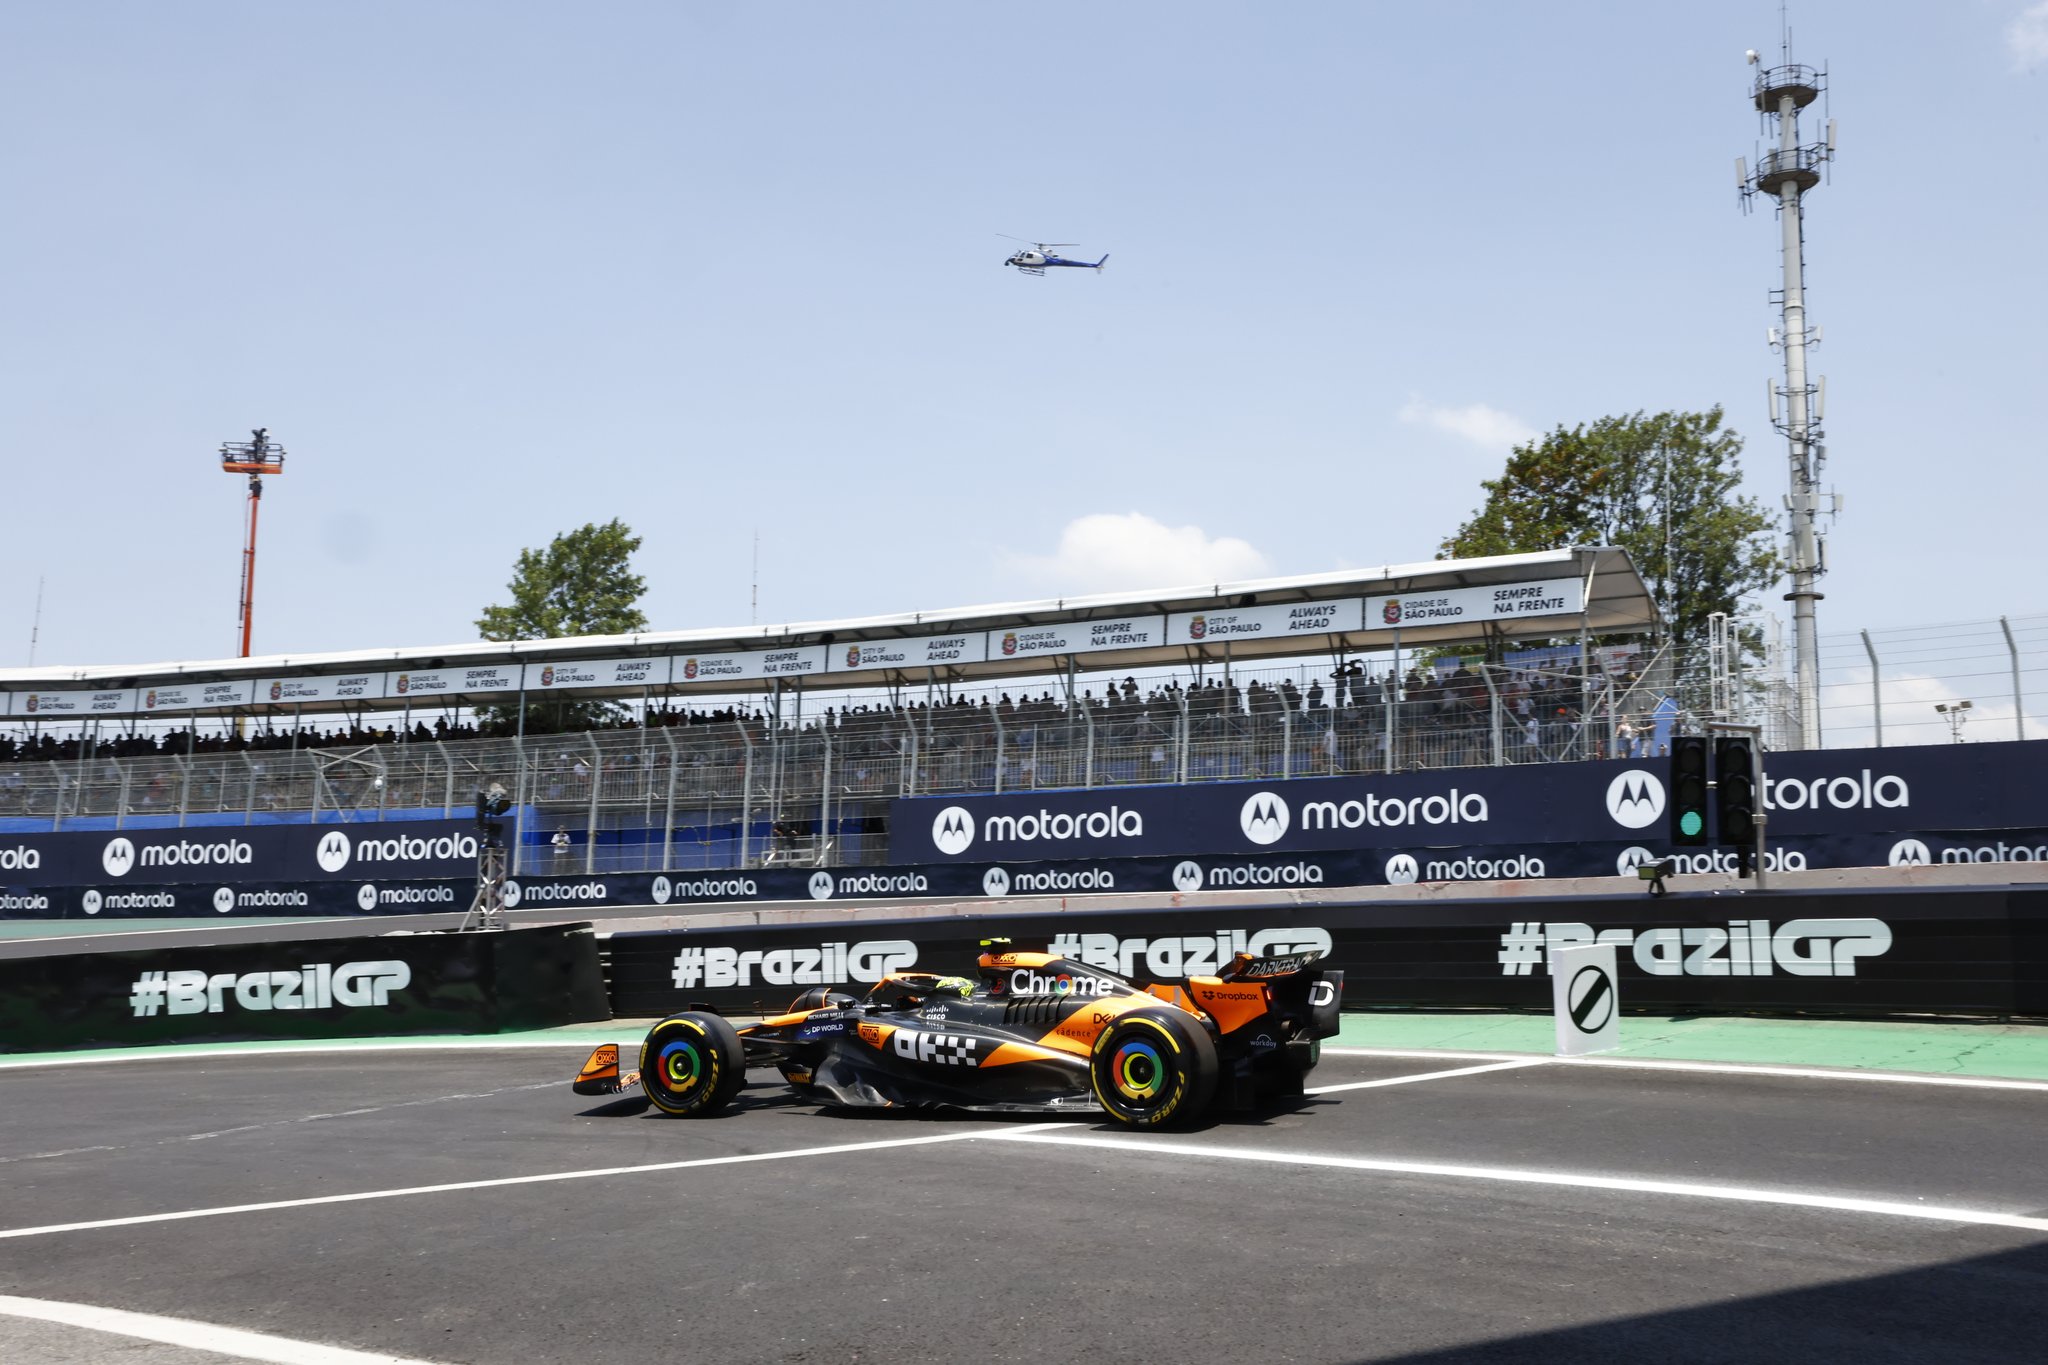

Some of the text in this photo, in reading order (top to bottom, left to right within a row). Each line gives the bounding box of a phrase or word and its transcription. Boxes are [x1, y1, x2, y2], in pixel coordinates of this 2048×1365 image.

[1493, 586, 1544, 601] SEMPRE
[1404, 598, 1449, 609] CIDADE DE
[1493, 597, 1564, 615] NA FRENTE
[1289, 604, 1337, 618] ALWAYS
[1404, 606, 1463, 620] SÃO PAULO
[1209, 616, 1238, 625] CITY OF
[1289, 618, 1330, 631] AHEAD
[1091, 622, 1132, 635] SEMPRE
[1209, 622, 1262, 636] SÃO PAULO
[1018, 631, 1055, 642] CIDADE DE
[1090, 632, 1148, 647] NA FRENTE
[862, 646, 886, 656] CITY OF
[927, 638, 966, 650] ALWAYS
[1018, 639, 1066, 651] SÃO PAULO
[764, 652, 799, 663] SEMPRE
[861, 653, 905, 665] SÃO PAULO
[927, 649, 960, 661] AHEAD
[615, 661, 652, 672] ALWAYS
[700, 665, 742, 676] SÃO PAULO
[701, 659, 733, 668] CIDADE DE
[763, 661, 813, 674] NA FRENTE
[466, 669, 497, 679] SEMPRE
[555, 673, 596, 683] SÃO PAULO
[615, 672, 646, 682] AHEAD
[410, 681, 447, 691] SÃO PAULO
[465, 678, 509, 689] NA FRENTE
[1751, 768, 1910, 810] torola
[1301, 788, 1489, 830] motorola
[984, 805, 1143, 842] motorola
[140, 839, 253, 867] motorola
[357, 832, 478, 862] motorola
[1427, 854, 1546, 880] motorola
[1665, 847, 1807, 875] motoola
[1015, 867, 1115, 891] motorola
[1210, 861, 1324, 886] motorola
[675, 876, 758, 898] motorola
[839, 871, 929, 894] motorola
[237, 889, 309, 907] motorola
[379, 885, 454, 904] motorola
[524, 881, 607, 901] motorola
[105, 891, 176, 909] motorola
[671, 939, 919, 989] #BrazilGP
[128, 959, 412, 1017] #BrazilGP
[1010, 968, 1114, 996] Chrome
[1216, 991, 1259, 1001] Dropbox
[926, 1013, 946, 1021] CISCO
[811, 1026, 821, 1034] DP
[821, 1023, 844, 1033] WORLD
[894, 1029, 977, 1067] OKX
[1250, 1039, 1277, 1049] workday
[1150, 1085, 1184, 1124] ZERO
